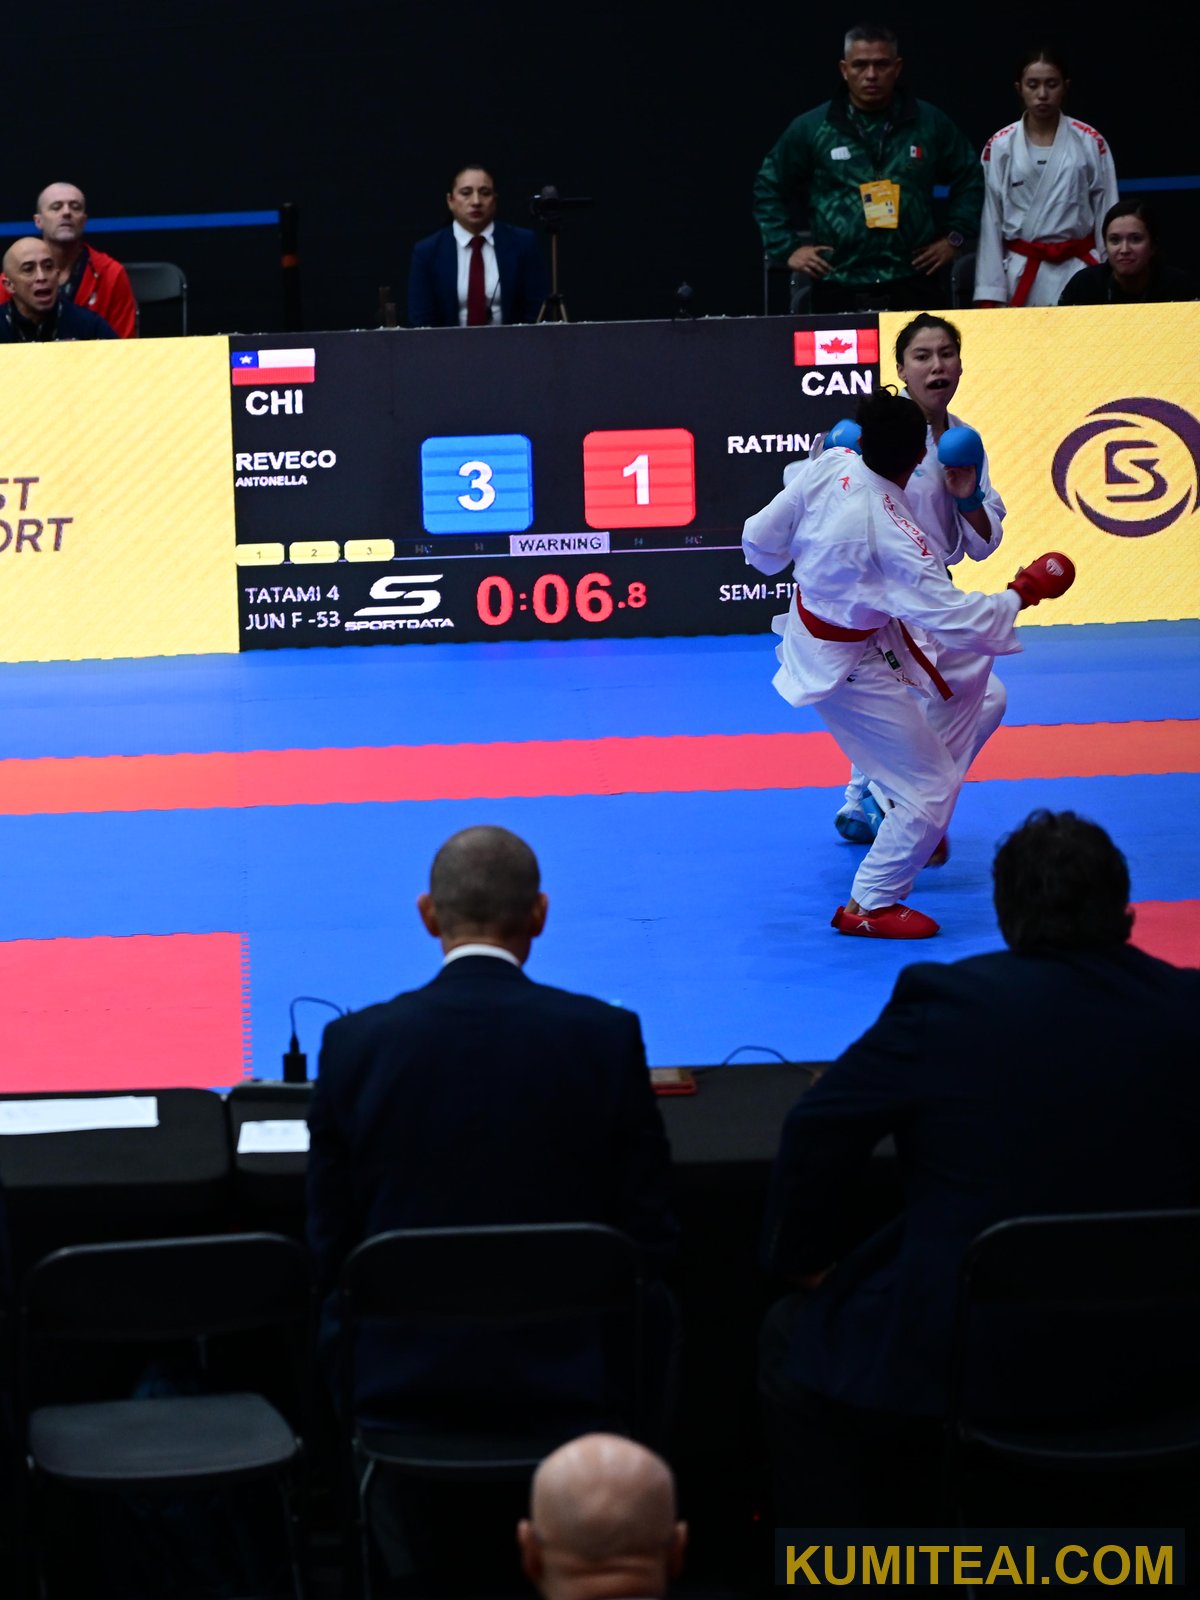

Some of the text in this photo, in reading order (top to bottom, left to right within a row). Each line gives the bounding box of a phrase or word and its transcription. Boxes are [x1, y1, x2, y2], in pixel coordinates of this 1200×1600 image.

[801, 370, 873, 396] CAN
[245, 389, 304, 416] CHI
[235, 449, 337, 472] REVECO
[235, 474, 308, 488] ANTONELLA
[457, 460, 496, 511] 3
[622, 454, 650, 505] 1
[518, 536, 602, 552] WARNING
[245, 585, 340, 604] TATAMI 4
[245, 611, 340, 630] JUN F -53
[345, 618, 455, 632] SPORTDATA
